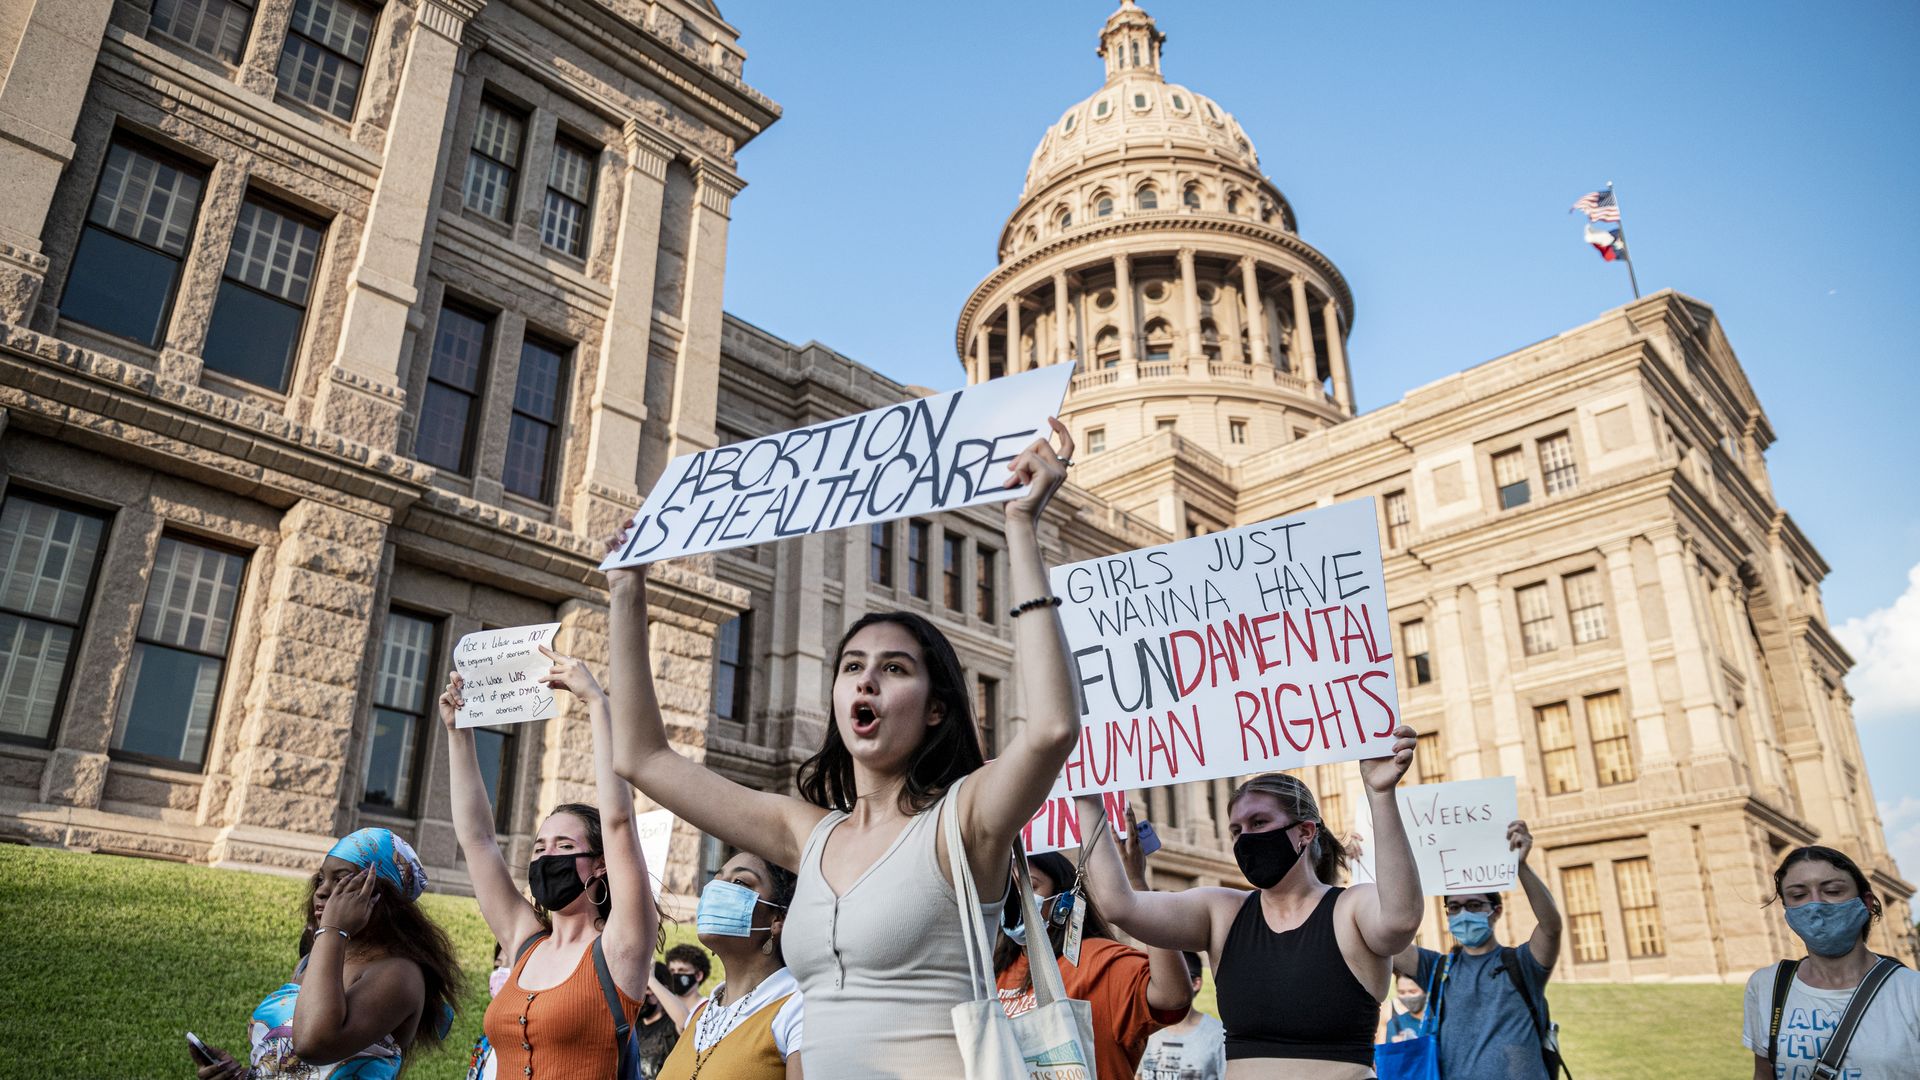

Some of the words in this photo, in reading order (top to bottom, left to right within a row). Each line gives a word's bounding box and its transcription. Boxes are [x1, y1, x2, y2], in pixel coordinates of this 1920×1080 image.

[661, 391, 962, 508] ABORTION
[621, 505, 683, 561] IS
[683, 428, 1038, 548] HEALTHCARE
[1067, 552, 1173, 604] GIRLS
[1207, 521, 1306, 572] JUST
[1088, 579, 1231, 637] WANNA
[1255, 551, 1370, 611] HAVE
[1071, 603, 1393, 716] FUNDAMENTAL
[1065, 704, 1206, 792] HUMAN
[1234, 670, 1395, 761] RIGHTS
[1406, 792, 1493, 827] WEEKS
[1419, 833, 1437, 847] IS
[1439, 849, 1516, 887] ENOUGH
[1771, 1007, 1781, 1036] Nikon
